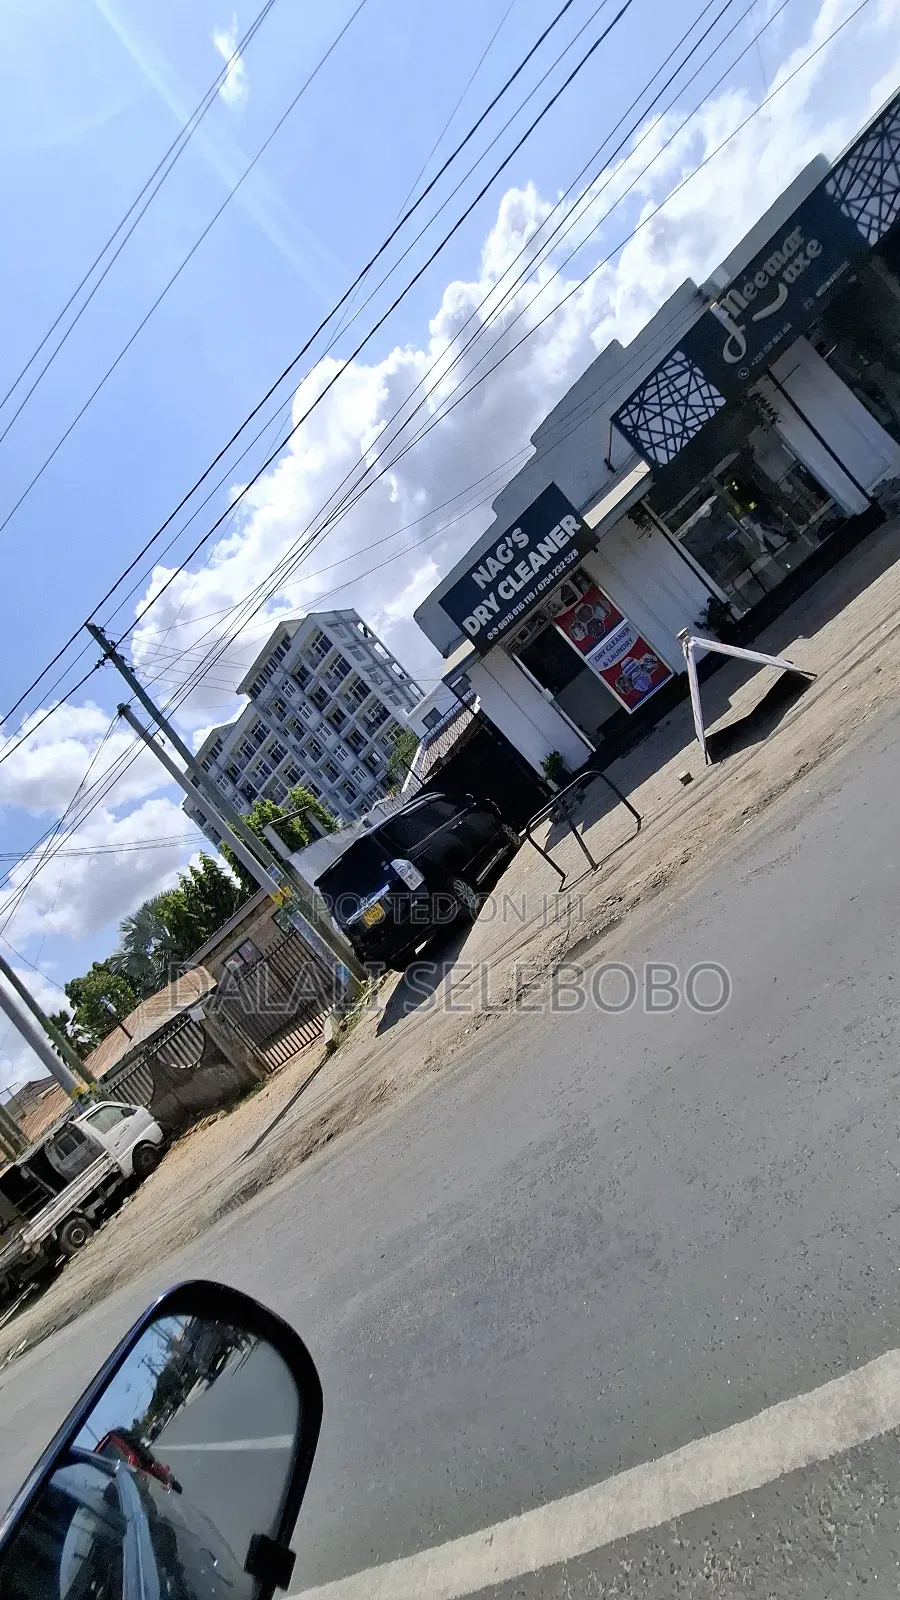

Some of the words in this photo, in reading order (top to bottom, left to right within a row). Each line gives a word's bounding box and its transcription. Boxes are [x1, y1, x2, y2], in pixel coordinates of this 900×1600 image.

[709, 225, 804, 322] Meemar
[462, 593, 500, 637] DRY
[498, 515, 582, 600] CLEANER
[471, 527, 529, 589] NAG'S
[497, 613, 514, 630] 0676
[512, 603, 525, 615] 016
[524, 592, 535, 604] 119
[537, 573, 554, 591] 0754
[552, 561, 566, 576] 232
[564, 548, 579, 564] 528
[594, 647, 607, 662] DRY
[605, 627, 631, 653] CLEANER
[607, 638, 634, 663] LAUNDRY
